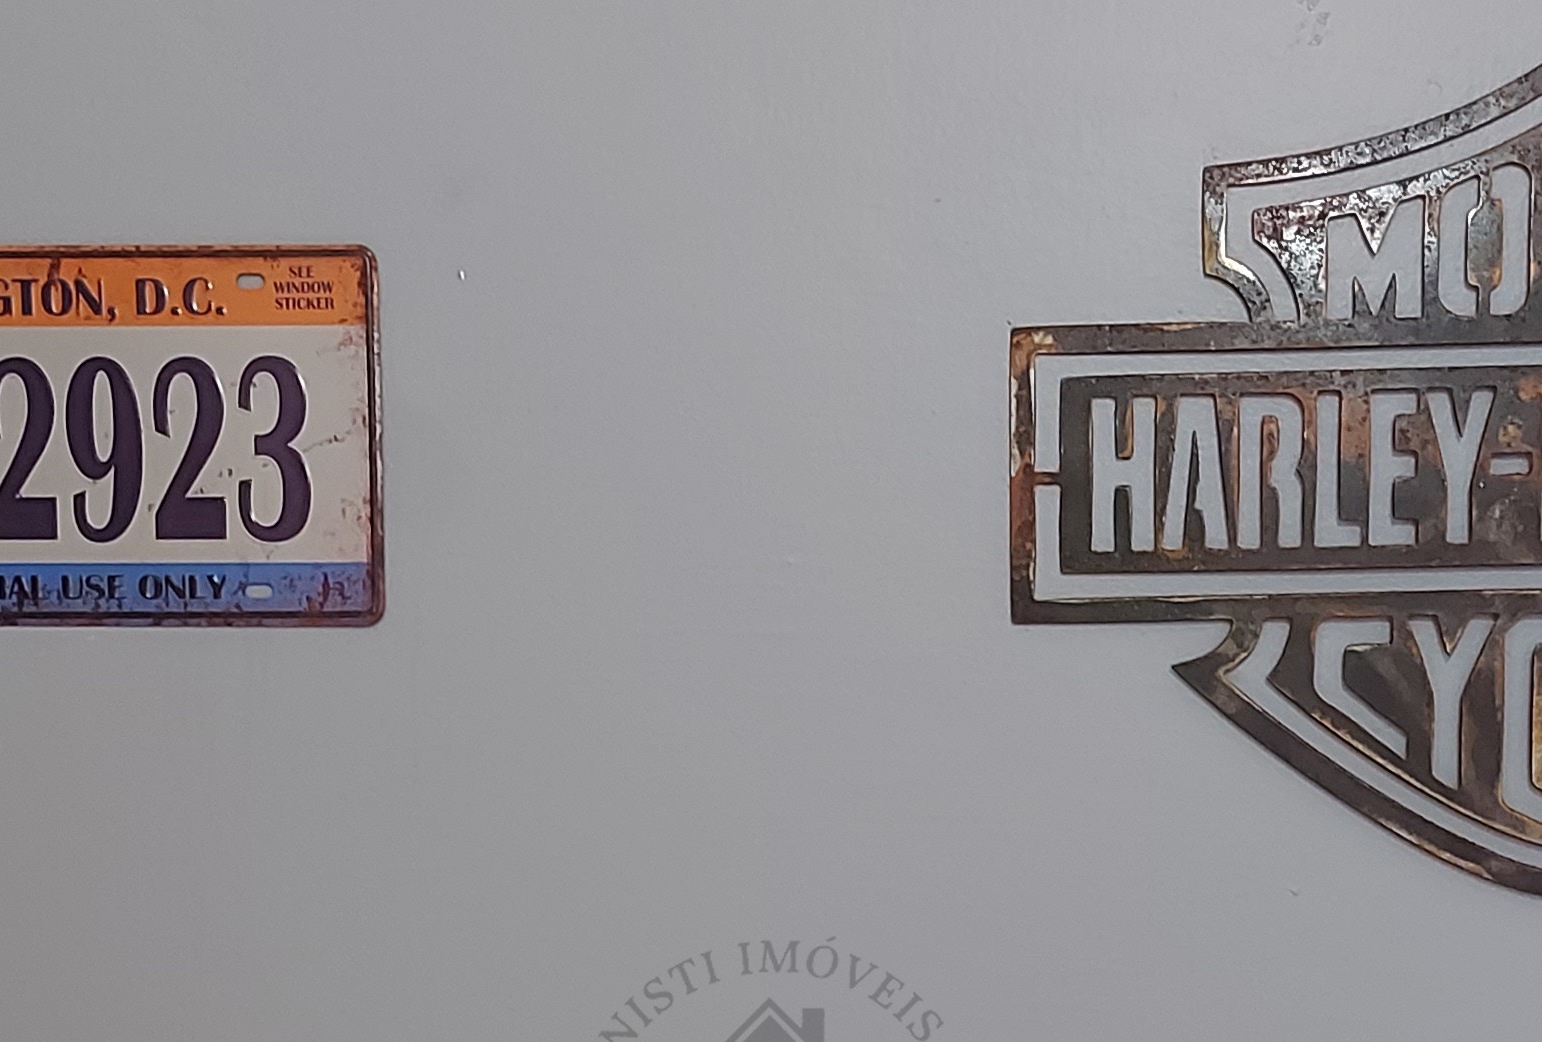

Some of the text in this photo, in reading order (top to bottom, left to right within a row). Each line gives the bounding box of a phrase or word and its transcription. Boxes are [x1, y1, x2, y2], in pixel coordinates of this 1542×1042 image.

[288, 266, 314, 279] SEE
[273, 281, 334, 295] WINDOW
[135, 277, 227, 317] D.C.
[274, 297, 334, 311] STICKER
[61, 573, 126, 602] USE
[137, 572, 227, 602] ONLY
